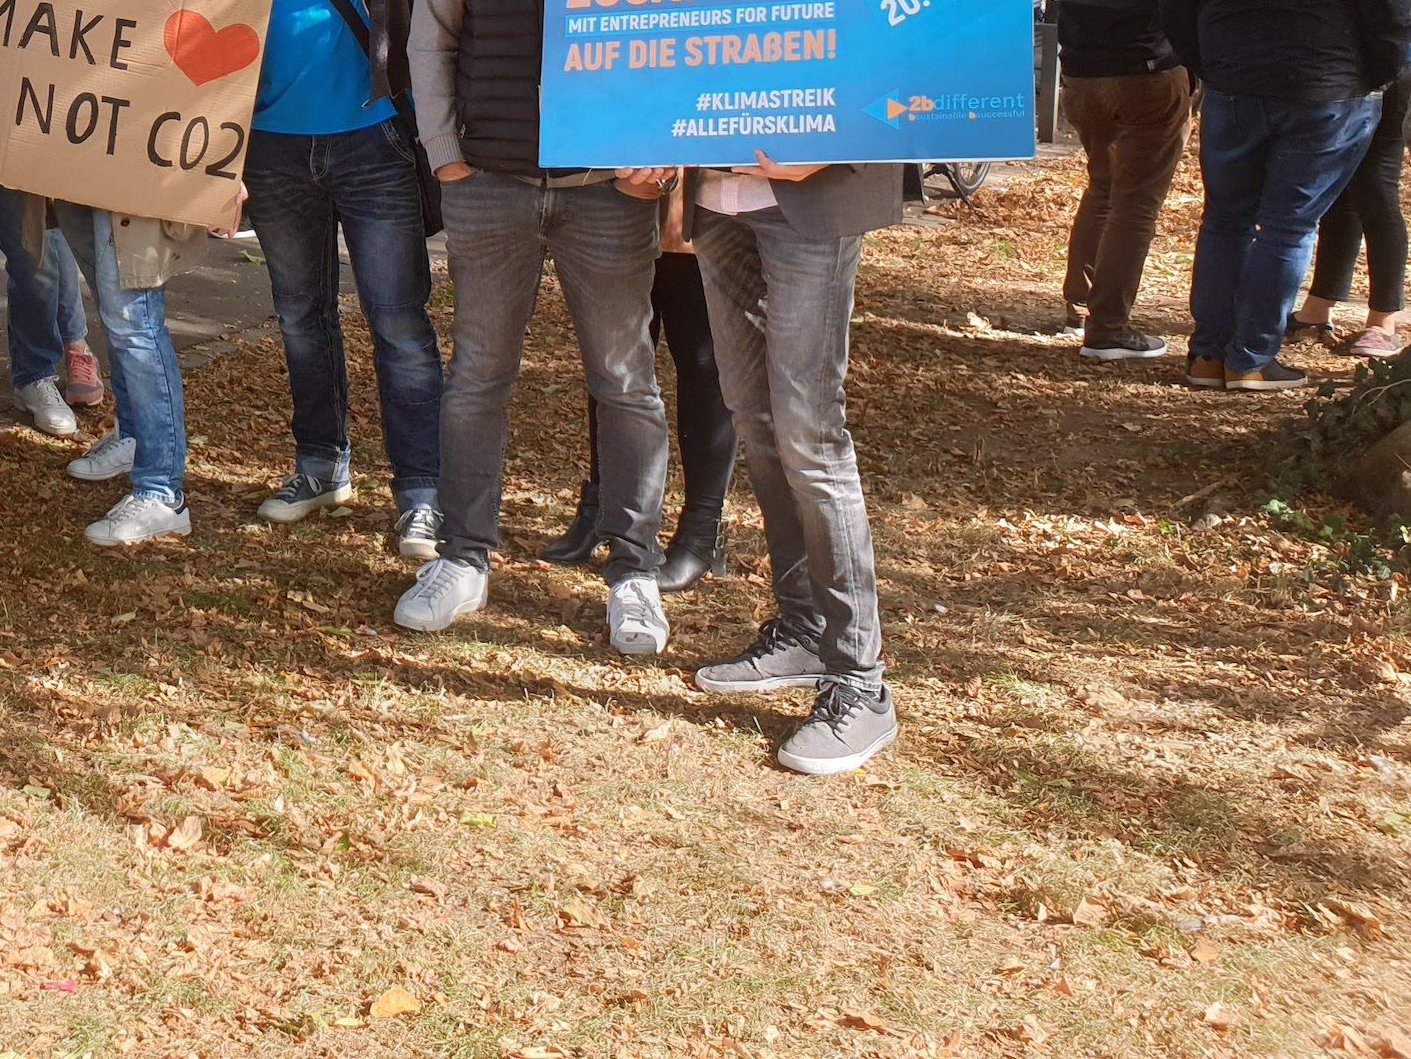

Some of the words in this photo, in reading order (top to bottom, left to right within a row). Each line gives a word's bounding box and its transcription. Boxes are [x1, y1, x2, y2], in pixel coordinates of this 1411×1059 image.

[568, 15, 597, 34] MIT
[600, 9, 733, 32] ENTREPRENEURS
[736, 5, 768, 25] FOR
[770, 1, 836, 22] FUTURE
[564, 42, 621, 73] AUF
[629, 39, 676, 70] DIE
[695, 87, 836, 112] #KLIMASTREIK
[908, 93, 1025, 112] 2bdifferent
[15, 76, 131, 156] NOT
[147, 110, 246, 181] CO2
[671, 110, 836, 138] #ALLEFÜRSKLIMA
